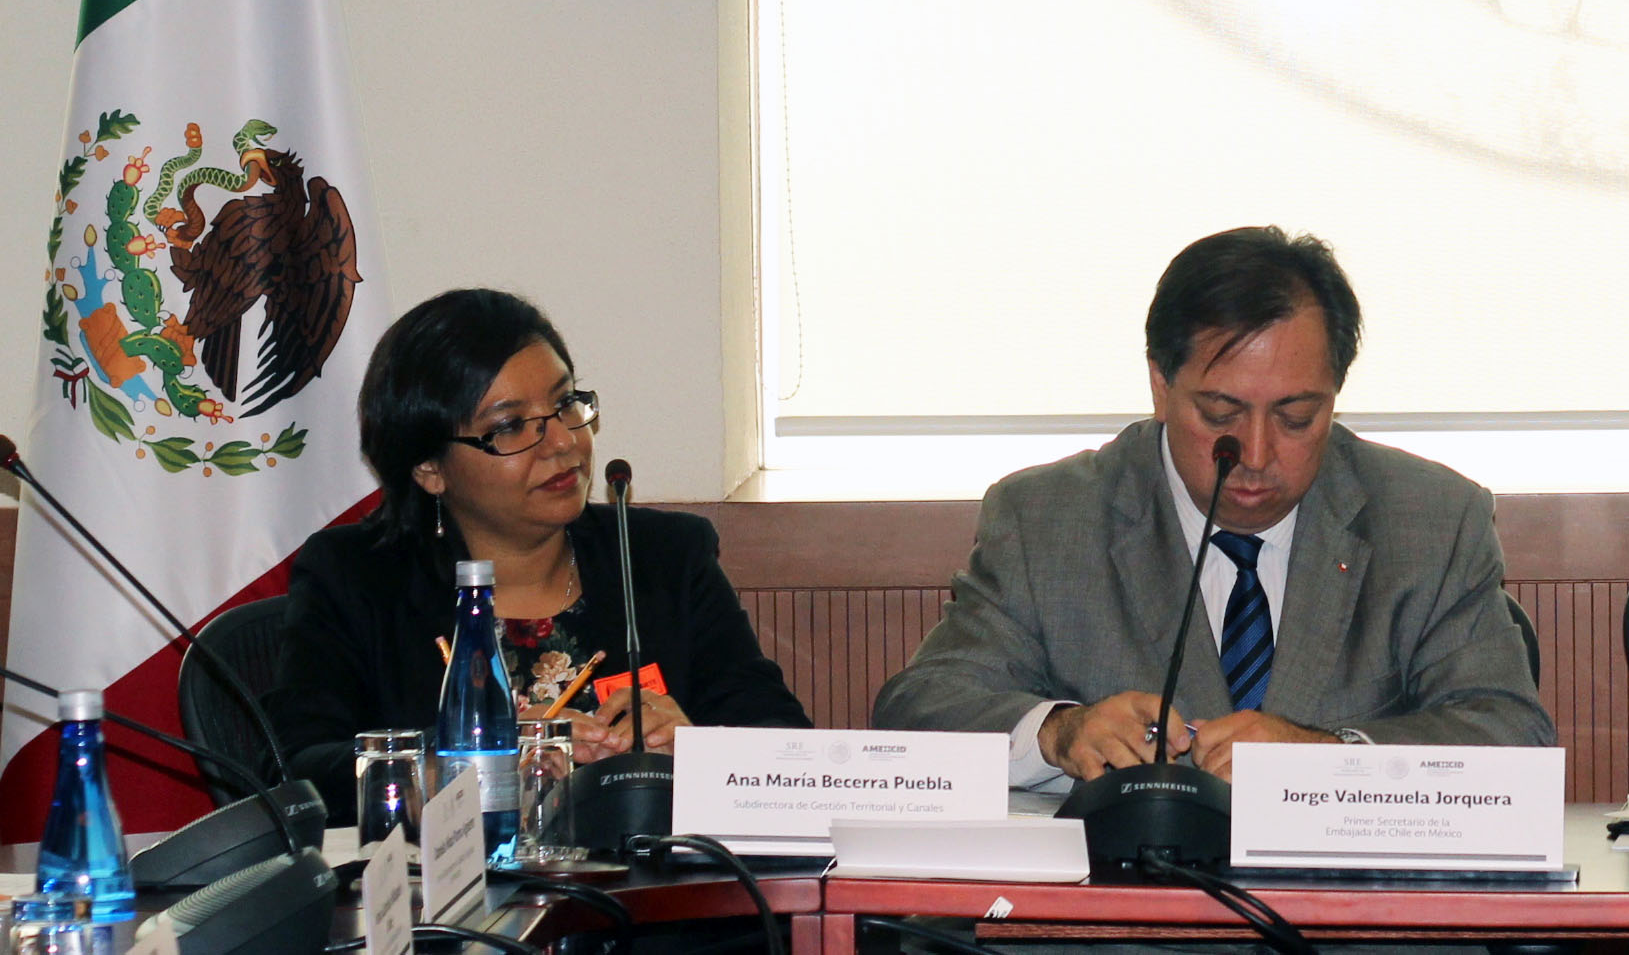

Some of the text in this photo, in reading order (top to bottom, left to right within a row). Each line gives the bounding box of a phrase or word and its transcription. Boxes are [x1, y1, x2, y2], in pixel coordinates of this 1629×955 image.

[726, 772, 953, 791] Ana María Becerra Puebla
[1133, 782, 1198, 794] SENNHEISER
[1282, 788, 1512, 808] Jorge Valenzuela Jorquera
[733, 799, 794, 811] Subdirectora
[796, 800, 808, 810] de
[810, 800, 847, 811] Gestión
[850, 801, 896, 812] Territorial
[906, 803, 944, 813] Canales
[1343, 816, 1450, 827] Primer Secretario de la
[1326, 828, 1463, 839] Embajada de Chile en México
